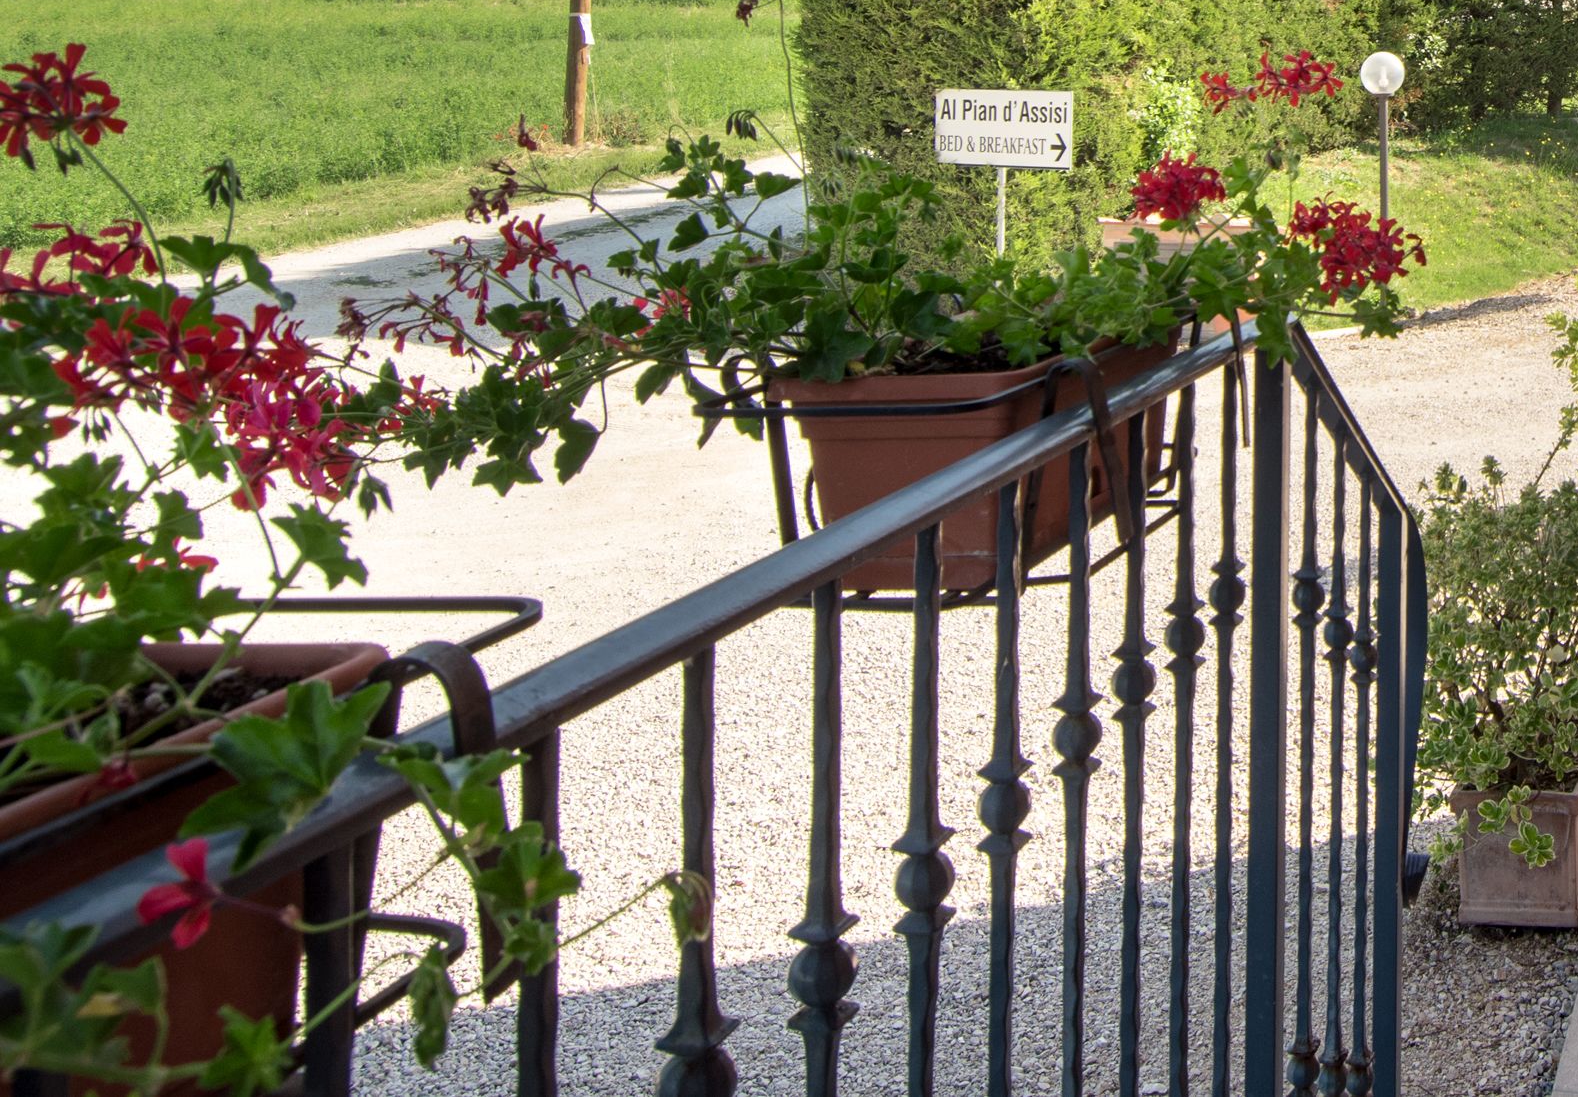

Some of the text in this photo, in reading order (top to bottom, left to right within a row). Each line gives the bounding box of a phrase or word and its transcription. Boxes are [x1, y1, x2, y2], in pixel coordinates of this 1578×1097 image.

[940, 98, 956, 121] Al
[962, 99, 998, 122] Pian
[939, 134, 1047, 155] BED & BREAKFAST
